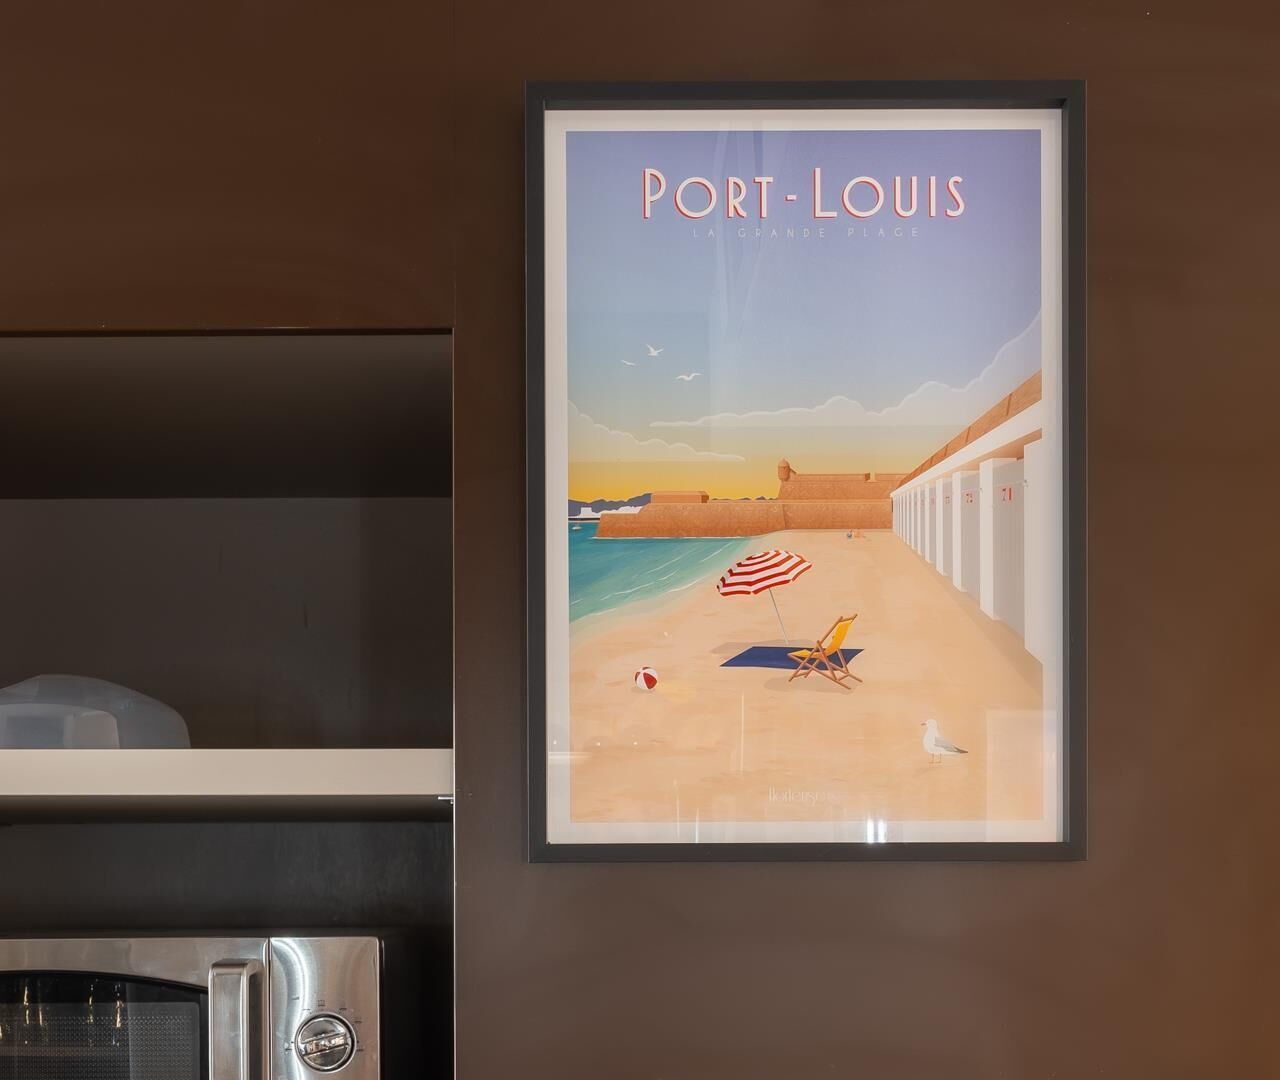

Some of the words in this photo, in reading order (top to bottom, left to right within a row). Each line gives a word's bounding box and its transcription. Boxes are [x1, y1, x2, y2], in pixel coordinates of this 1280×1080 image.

[693, 228, 717, 238] LA
[738, 228, 826, 238] GRANDE
[847, 227, 920, 237] PLAGE
